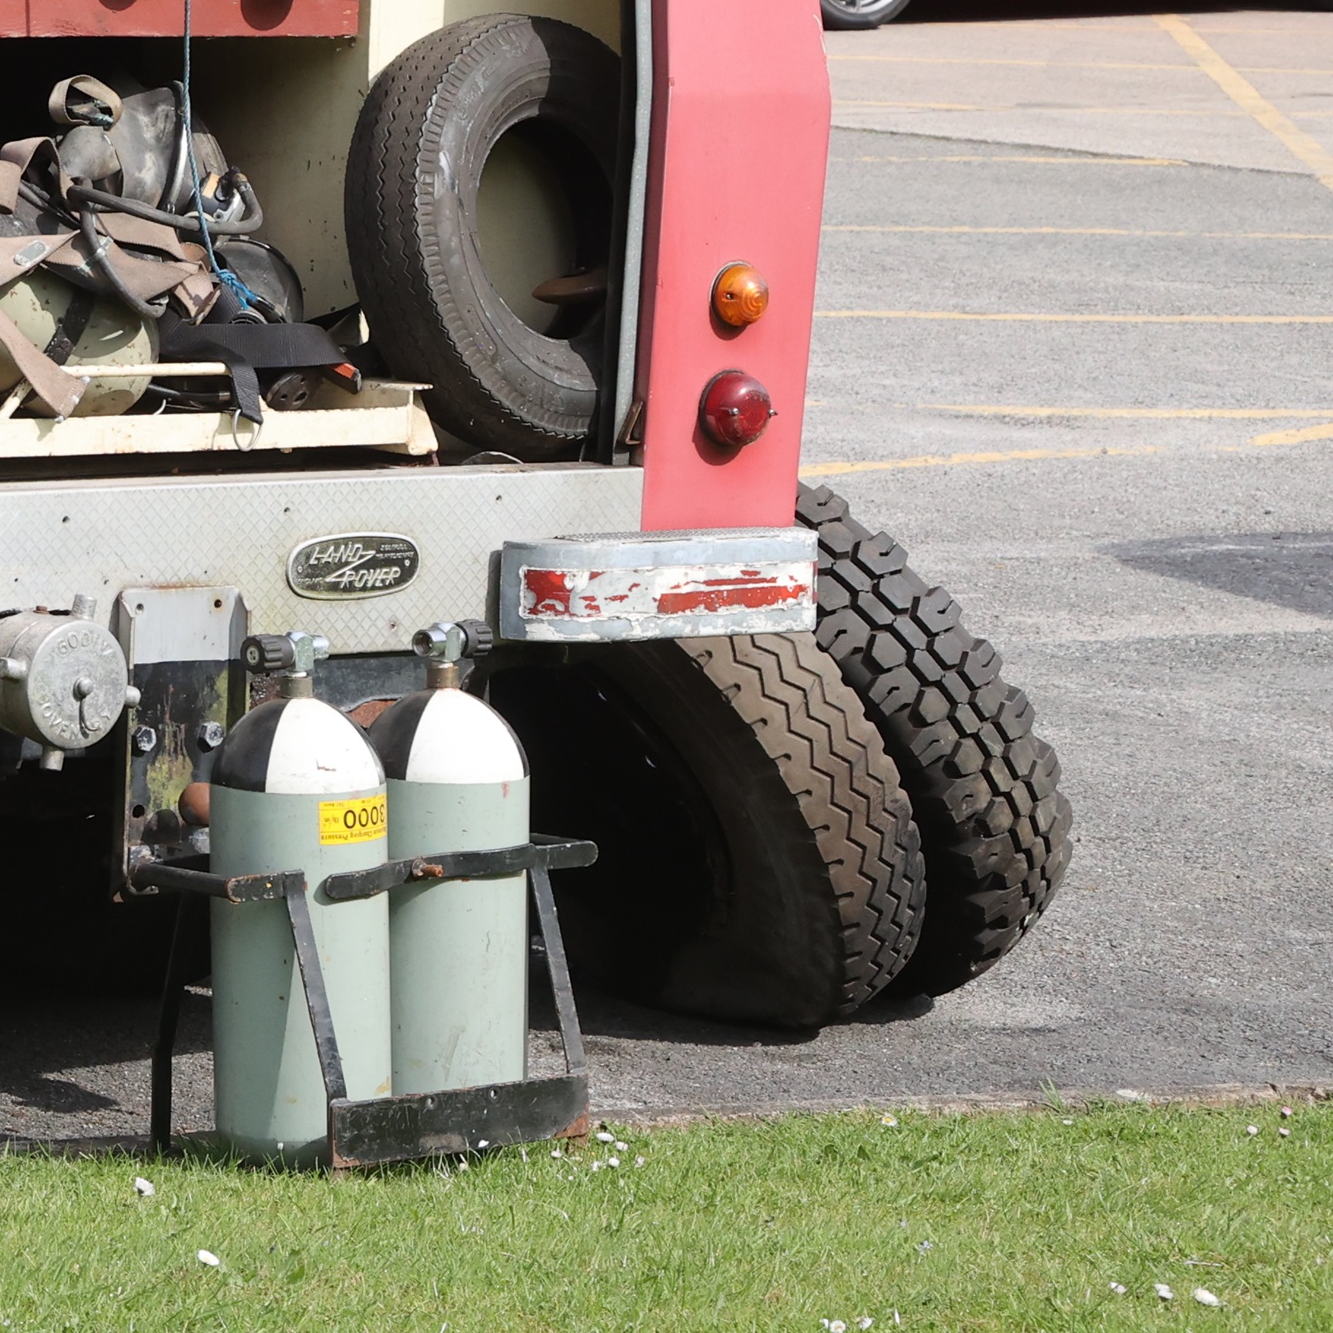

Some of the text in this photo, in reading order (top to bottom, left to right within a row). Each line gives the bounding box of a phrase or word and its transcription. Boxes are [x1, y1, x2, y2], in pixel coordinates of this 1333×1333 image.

[309, 543, 363, 564] LAND
[340, 567, 401, 588] ROVER
[343, 804, 385, 829] 3000
[321, 833, 349, 841] Pressure
